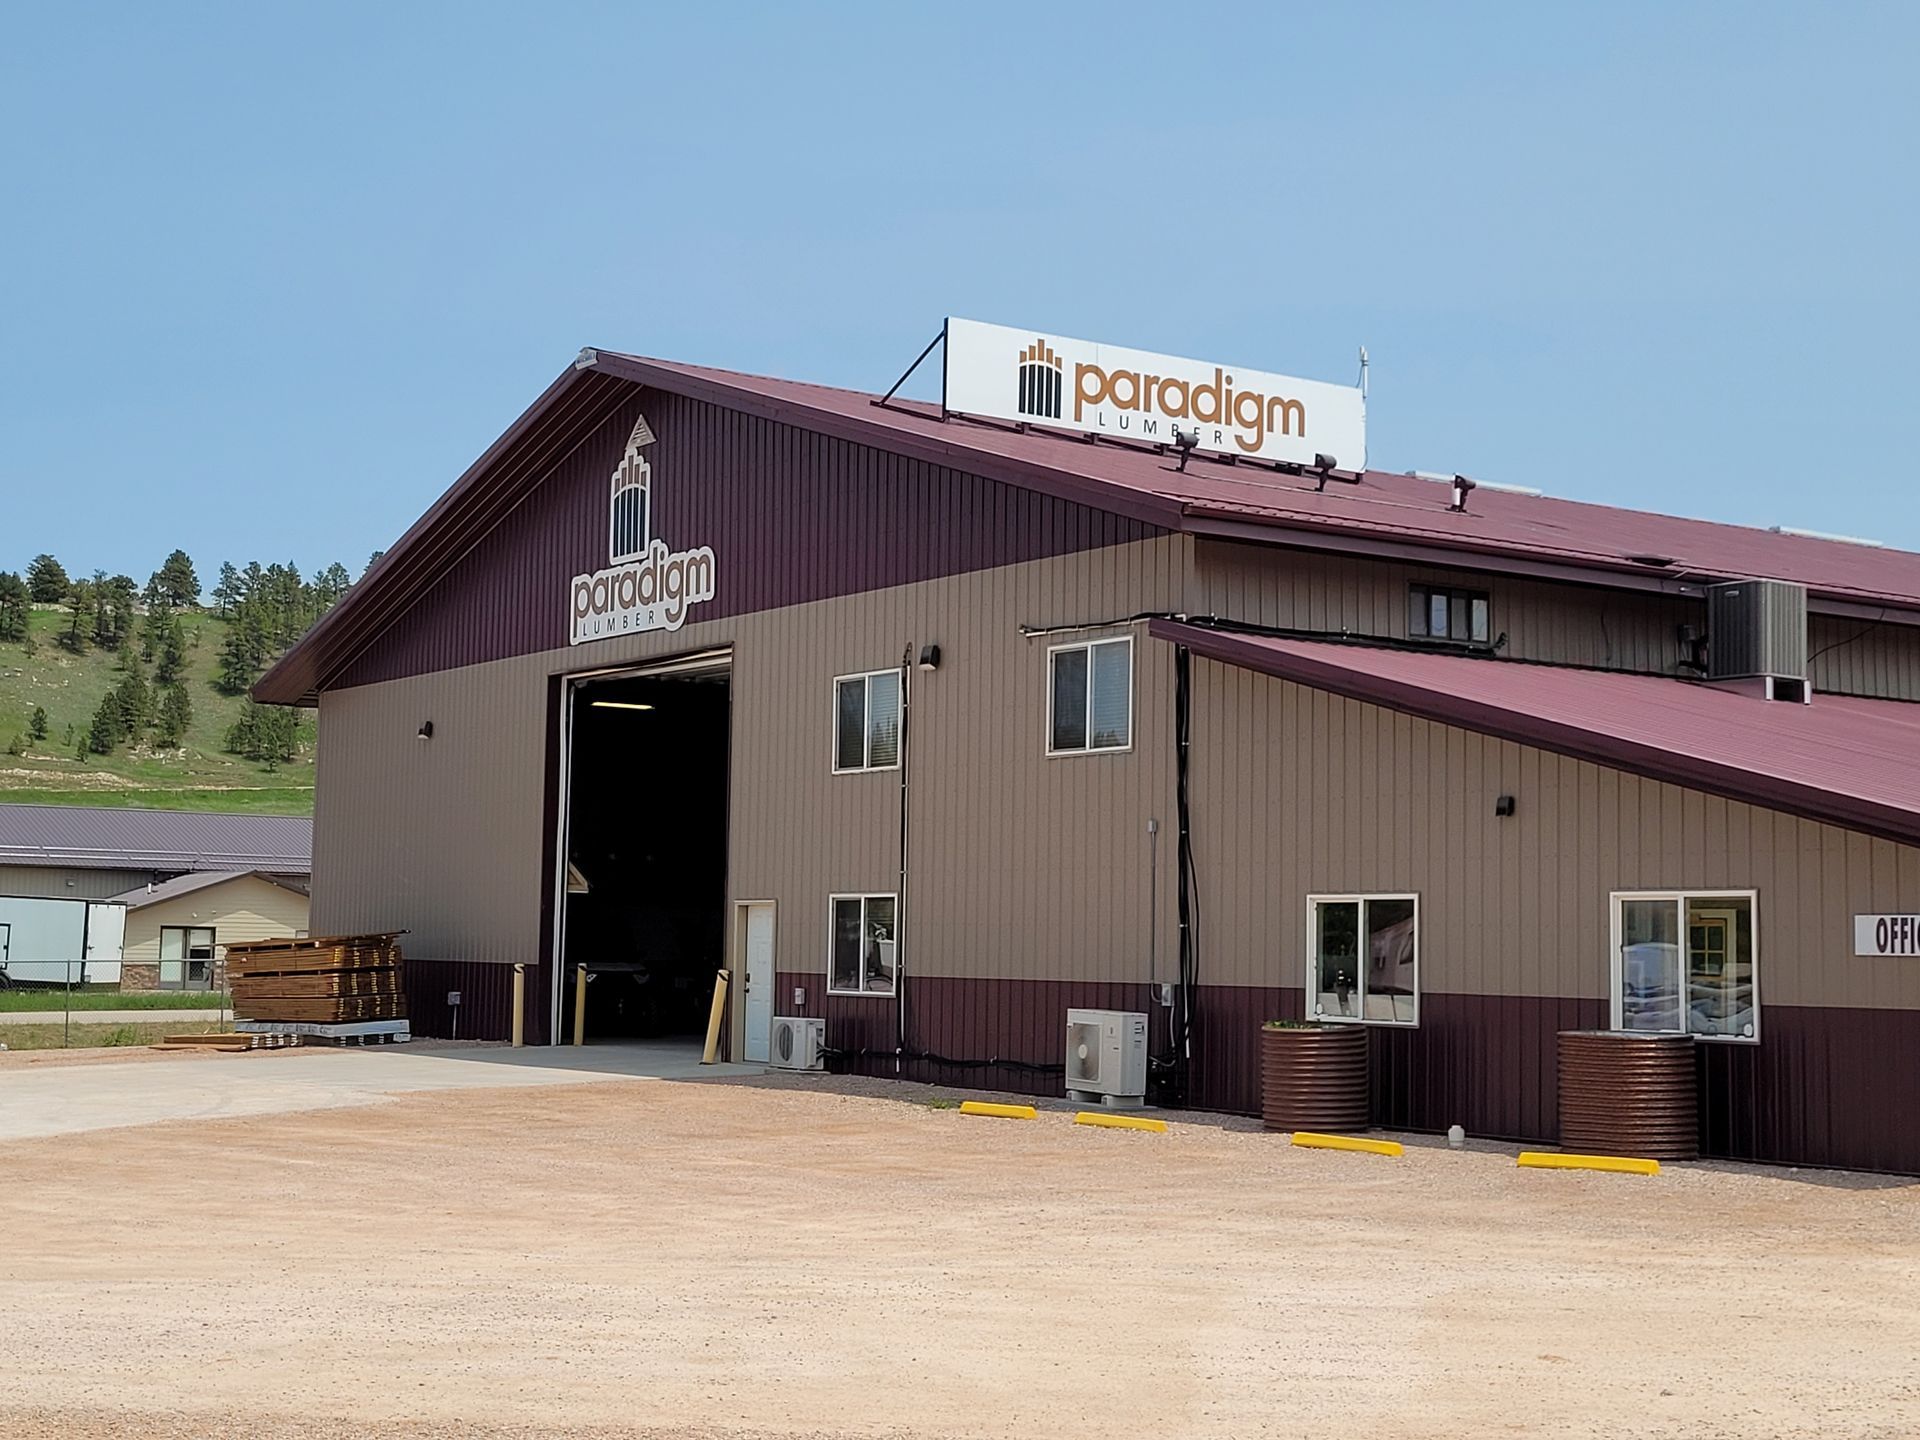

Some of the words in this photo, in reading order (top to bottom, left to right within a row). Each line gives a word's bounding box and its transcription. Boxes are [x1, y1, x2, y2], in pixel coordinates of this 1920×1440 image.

[1074, 362, 1305, 452] paradigm
[573, 547, 711, 638] paradigm
[583, 610, 655, 636] LUMBER
[1876, 917, 1920, 954] OFFI
